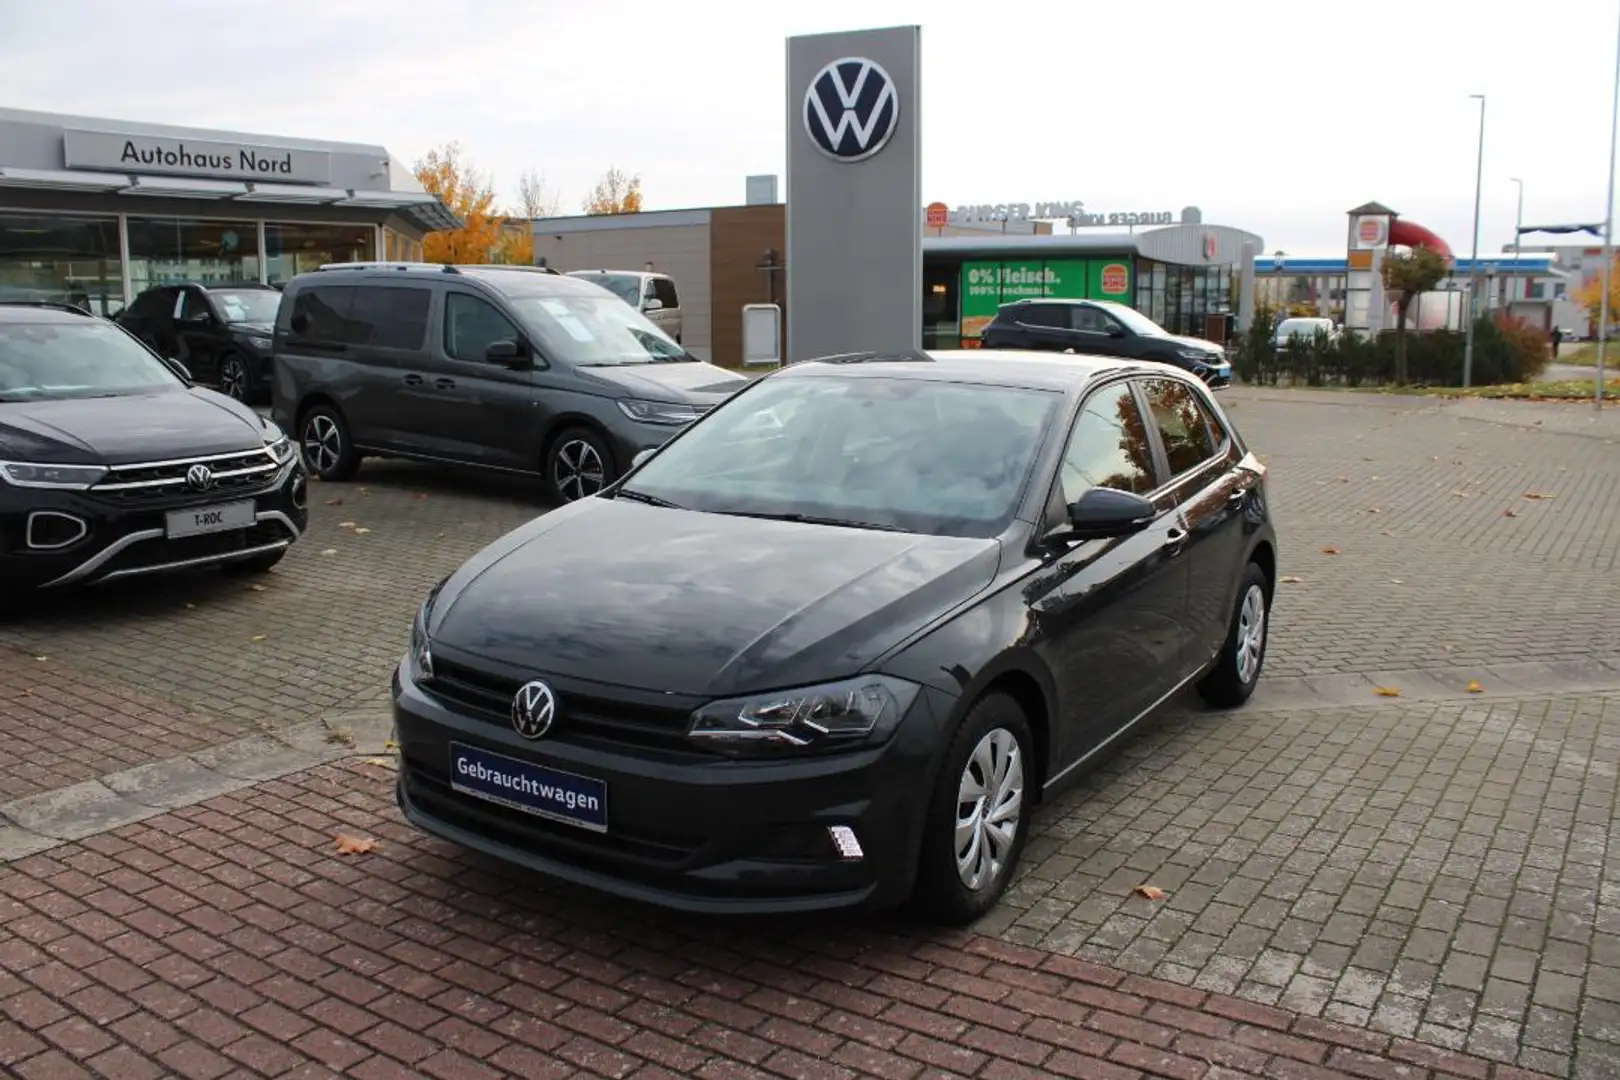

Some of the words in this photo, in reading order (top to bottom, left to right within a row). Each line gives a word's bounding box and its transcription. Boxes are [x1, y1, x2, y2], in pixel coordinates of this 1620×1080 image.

[121, 140, 232, 169] Autohaus
[239, 149, 291, 174] Nord
[968, 268, 994, 284] 0%
[996, 267, 1061, 284] Fleisch.
[194, 511, 223, 526] T-ROC
[457, 757, 599, 811] Gebrauchtwagen
